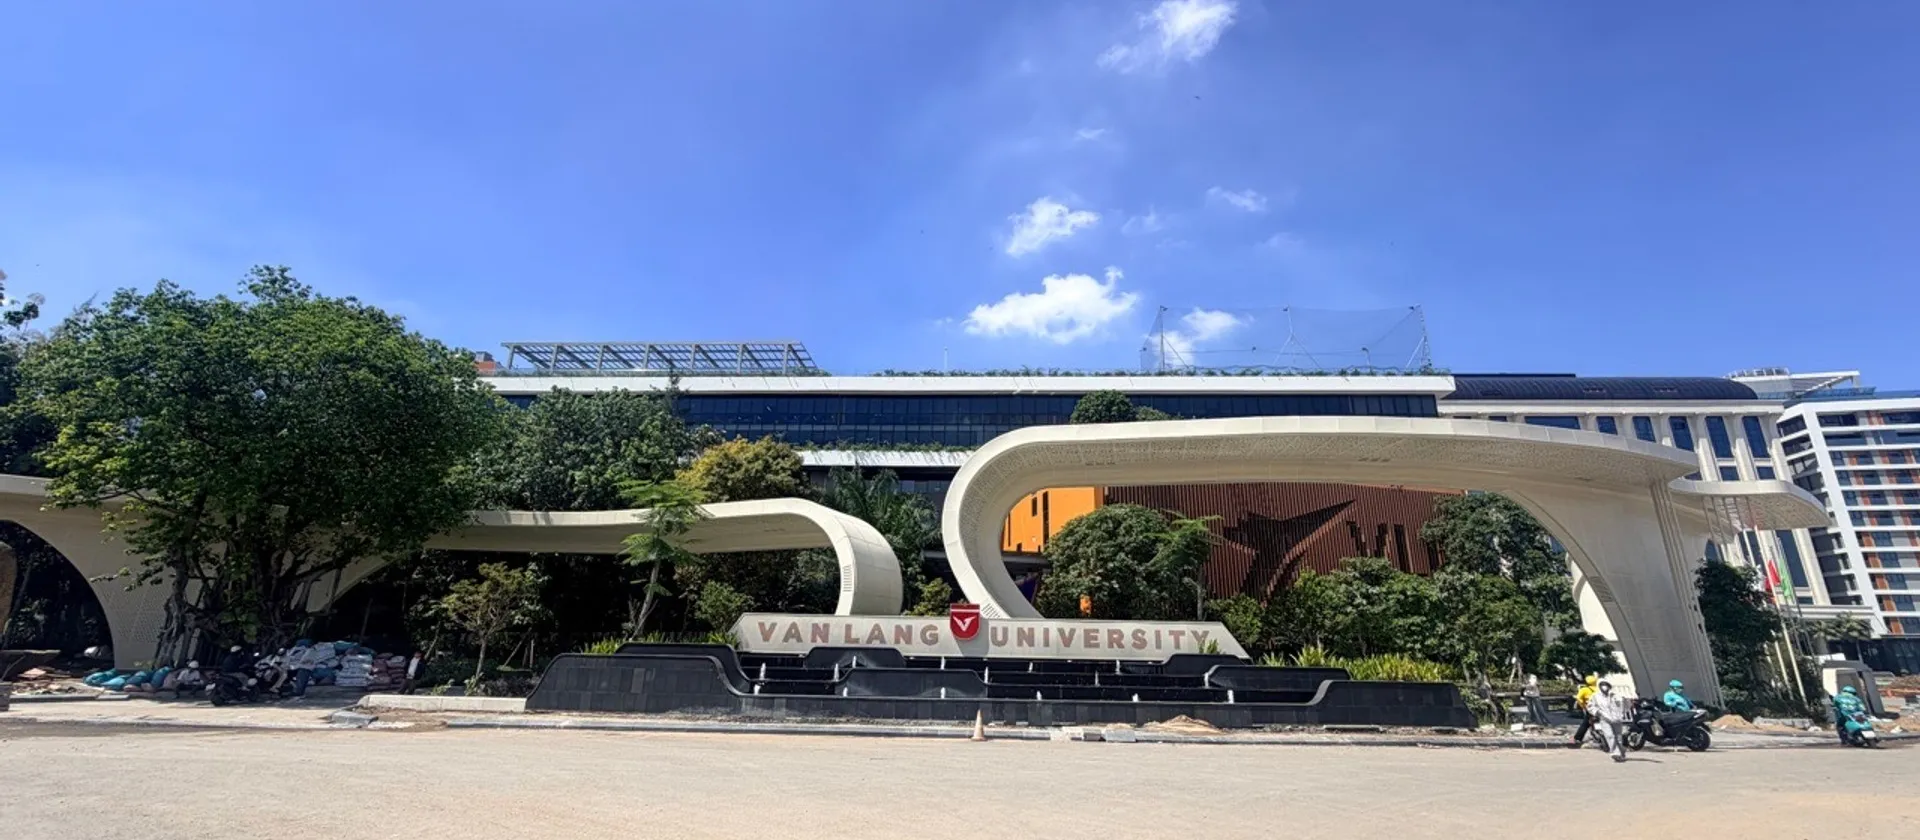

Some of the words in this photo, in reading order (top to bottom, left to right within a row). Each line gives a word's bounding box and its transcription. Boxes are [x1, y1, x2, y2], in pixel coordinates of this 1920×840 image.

[758, 621, 830, 643] VAN
[844, 623, 939, 646] LANG
[990, 626, 1210, 650] UNIVERSITY
